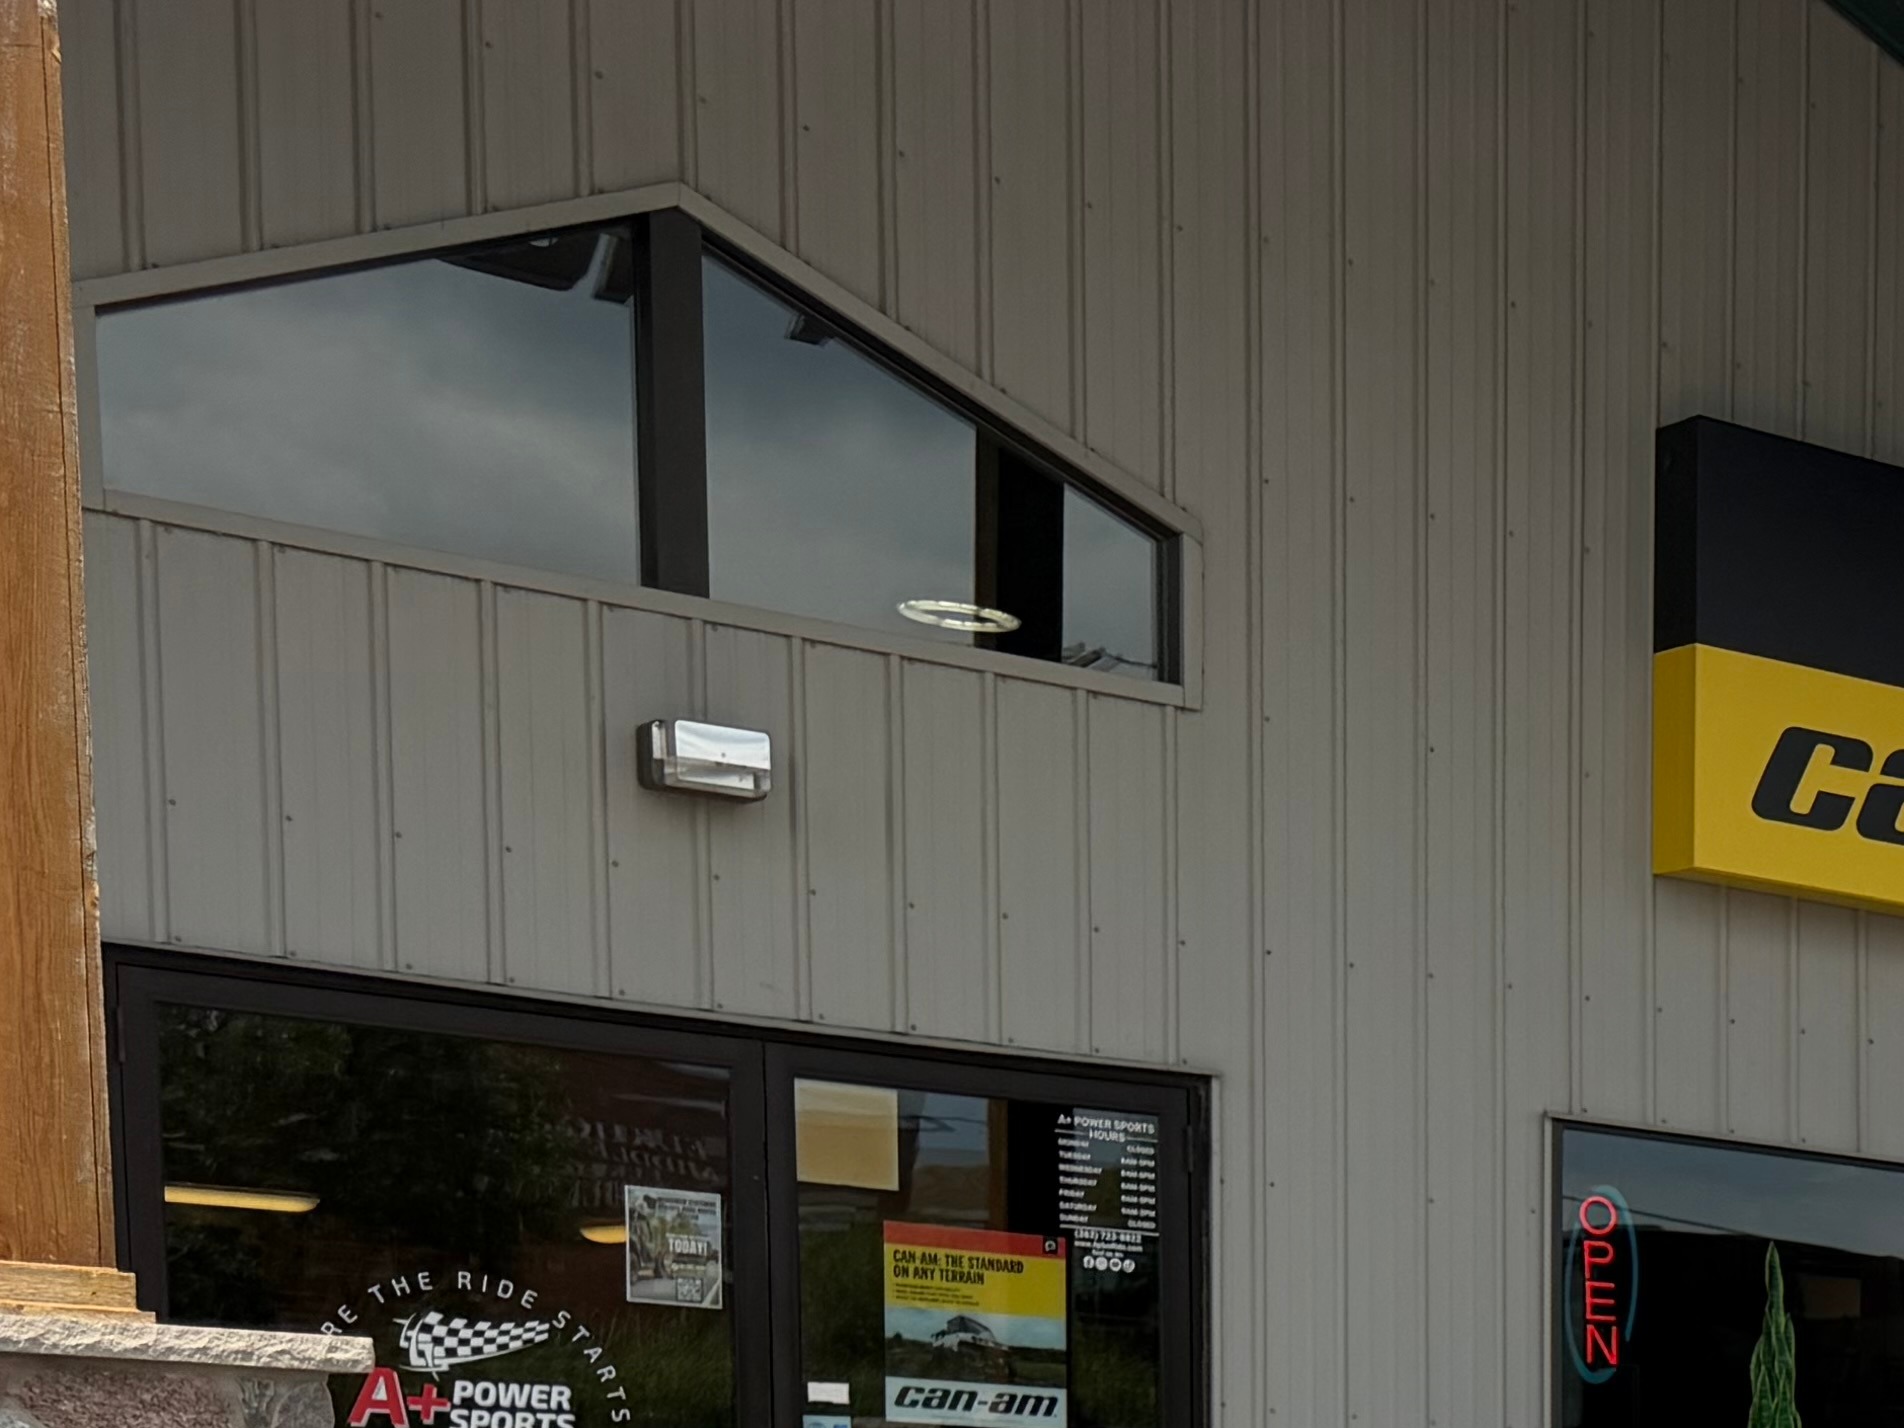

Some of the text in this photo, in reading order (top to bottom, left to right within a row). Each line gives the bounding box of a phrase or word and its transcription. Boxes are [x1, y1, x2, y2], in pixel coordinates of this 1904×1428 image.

[1074, 1116, 1112, 1129] POWER
[1114, 1120, 1155, 1134] SPORTS
[1089, 1129, 1126, 1143] HOURS
[893, 1265, 985, 1285] ON ANY TERRAIN
[945, 1254, 964, 1268] THE
[968, 1256, 1024, 1274] STANDARD
[1579, 1196, 1618, 1365] OPEN
[367, 1271, 433, 1304] THE
[457, 1271, 538, 1309] RIDE
[552, 1310, 631, 1423] STARTS
[453, 1380, 572, 1411] POWER
[894, 1386, 1058, 1418] can-am
